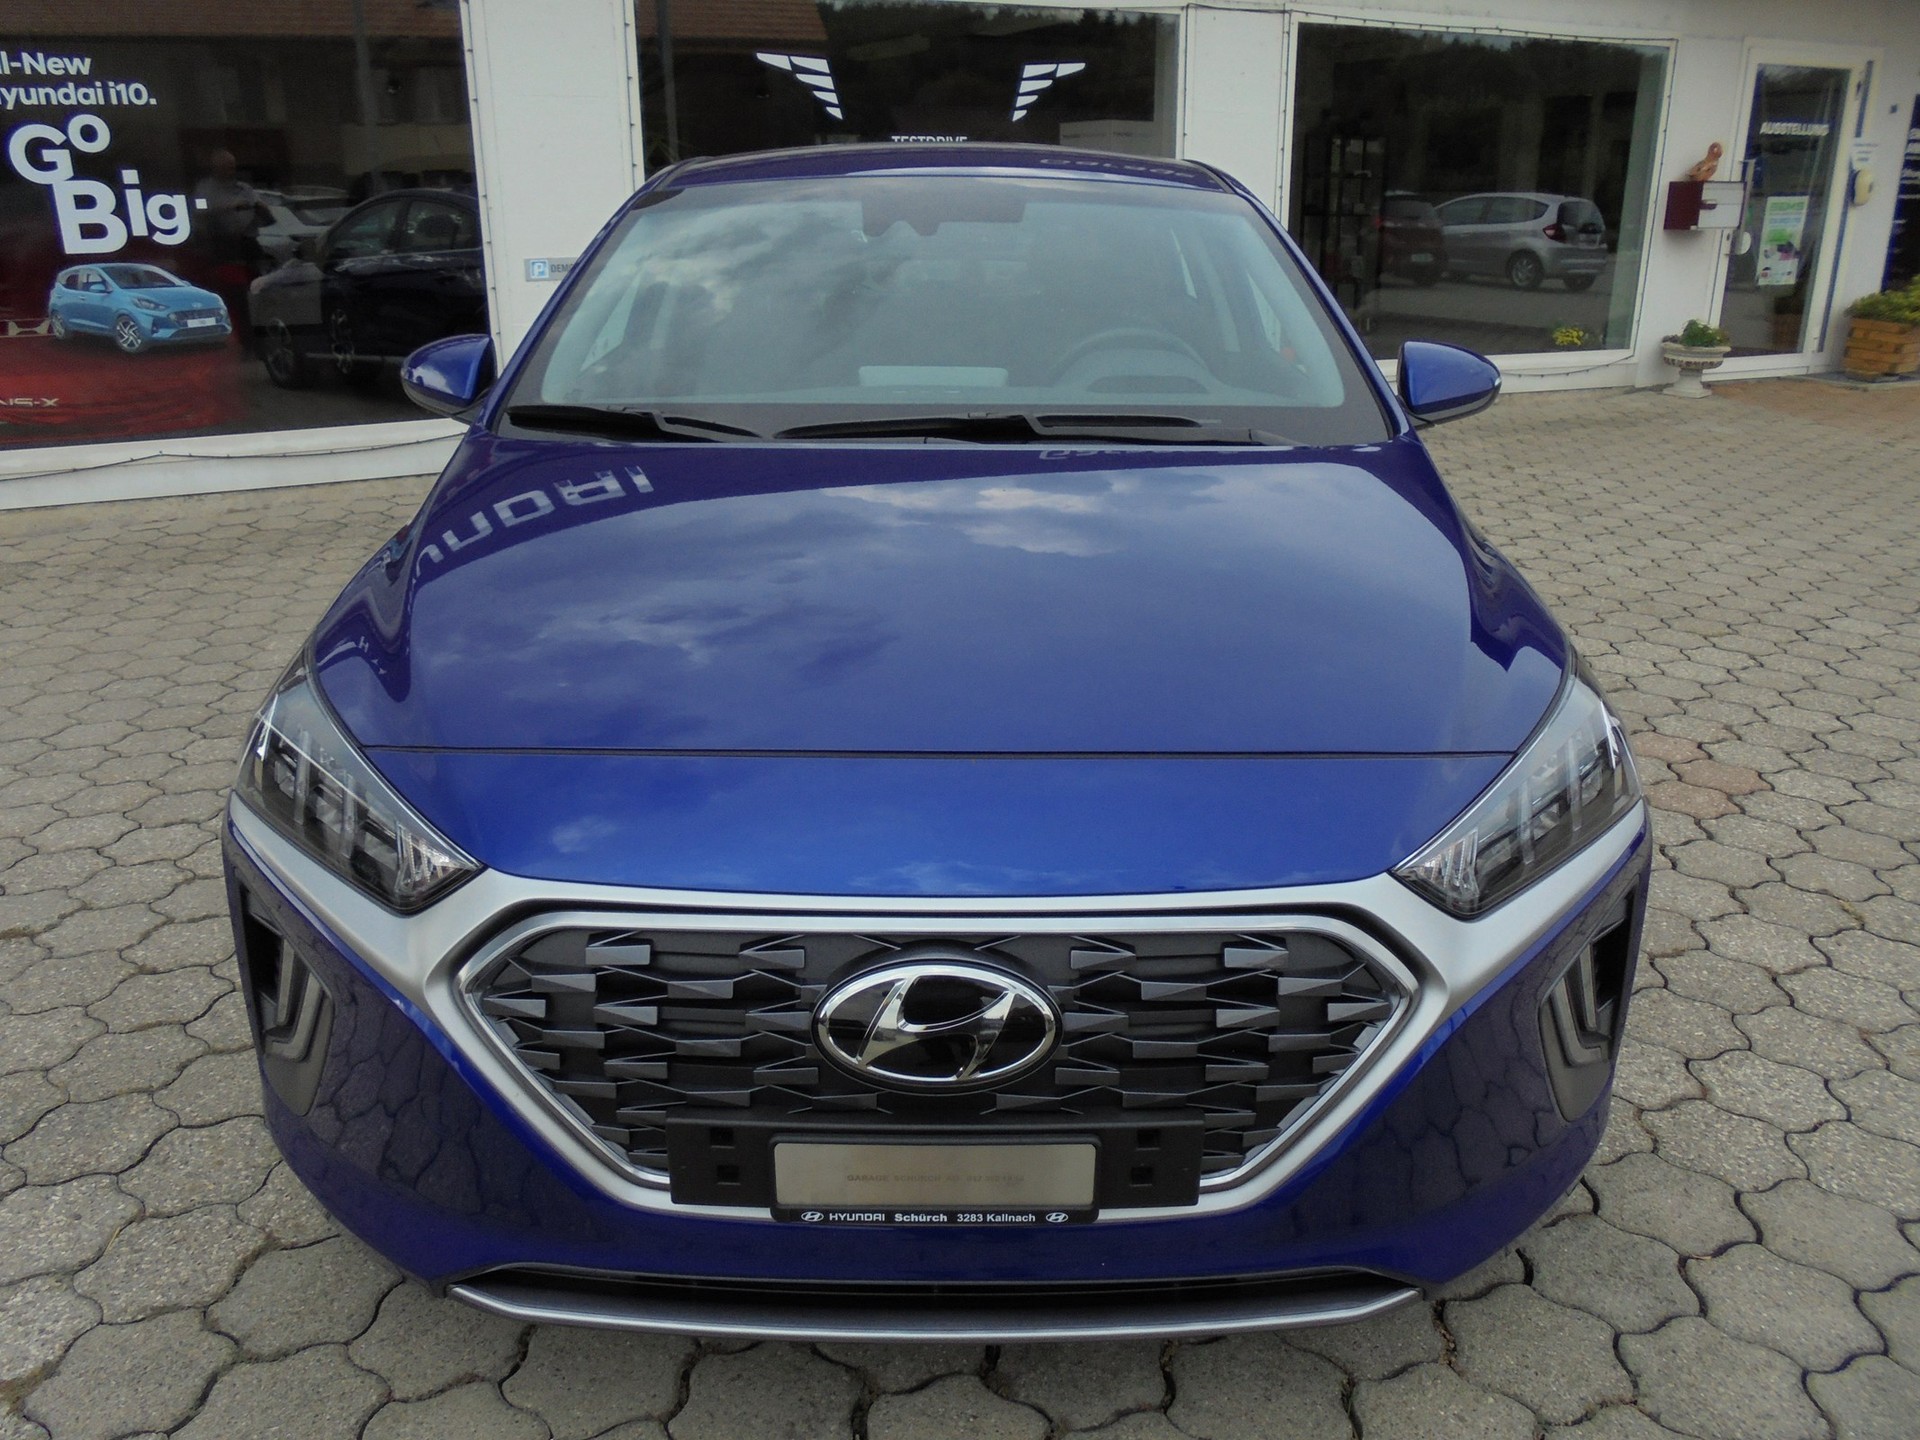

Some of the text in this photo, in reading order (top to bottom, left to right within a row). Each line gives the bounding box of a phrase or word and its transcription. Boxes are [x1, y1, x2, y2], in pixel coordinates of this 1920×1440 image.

[0, 51, 91, 75] l-New
[0, 82, 157, 110] yundai i10.
[9, 114, 111, 184] Go
[829, 1213, 1036, 1222] HYUNDAI Schürch 3283 Kallnach
